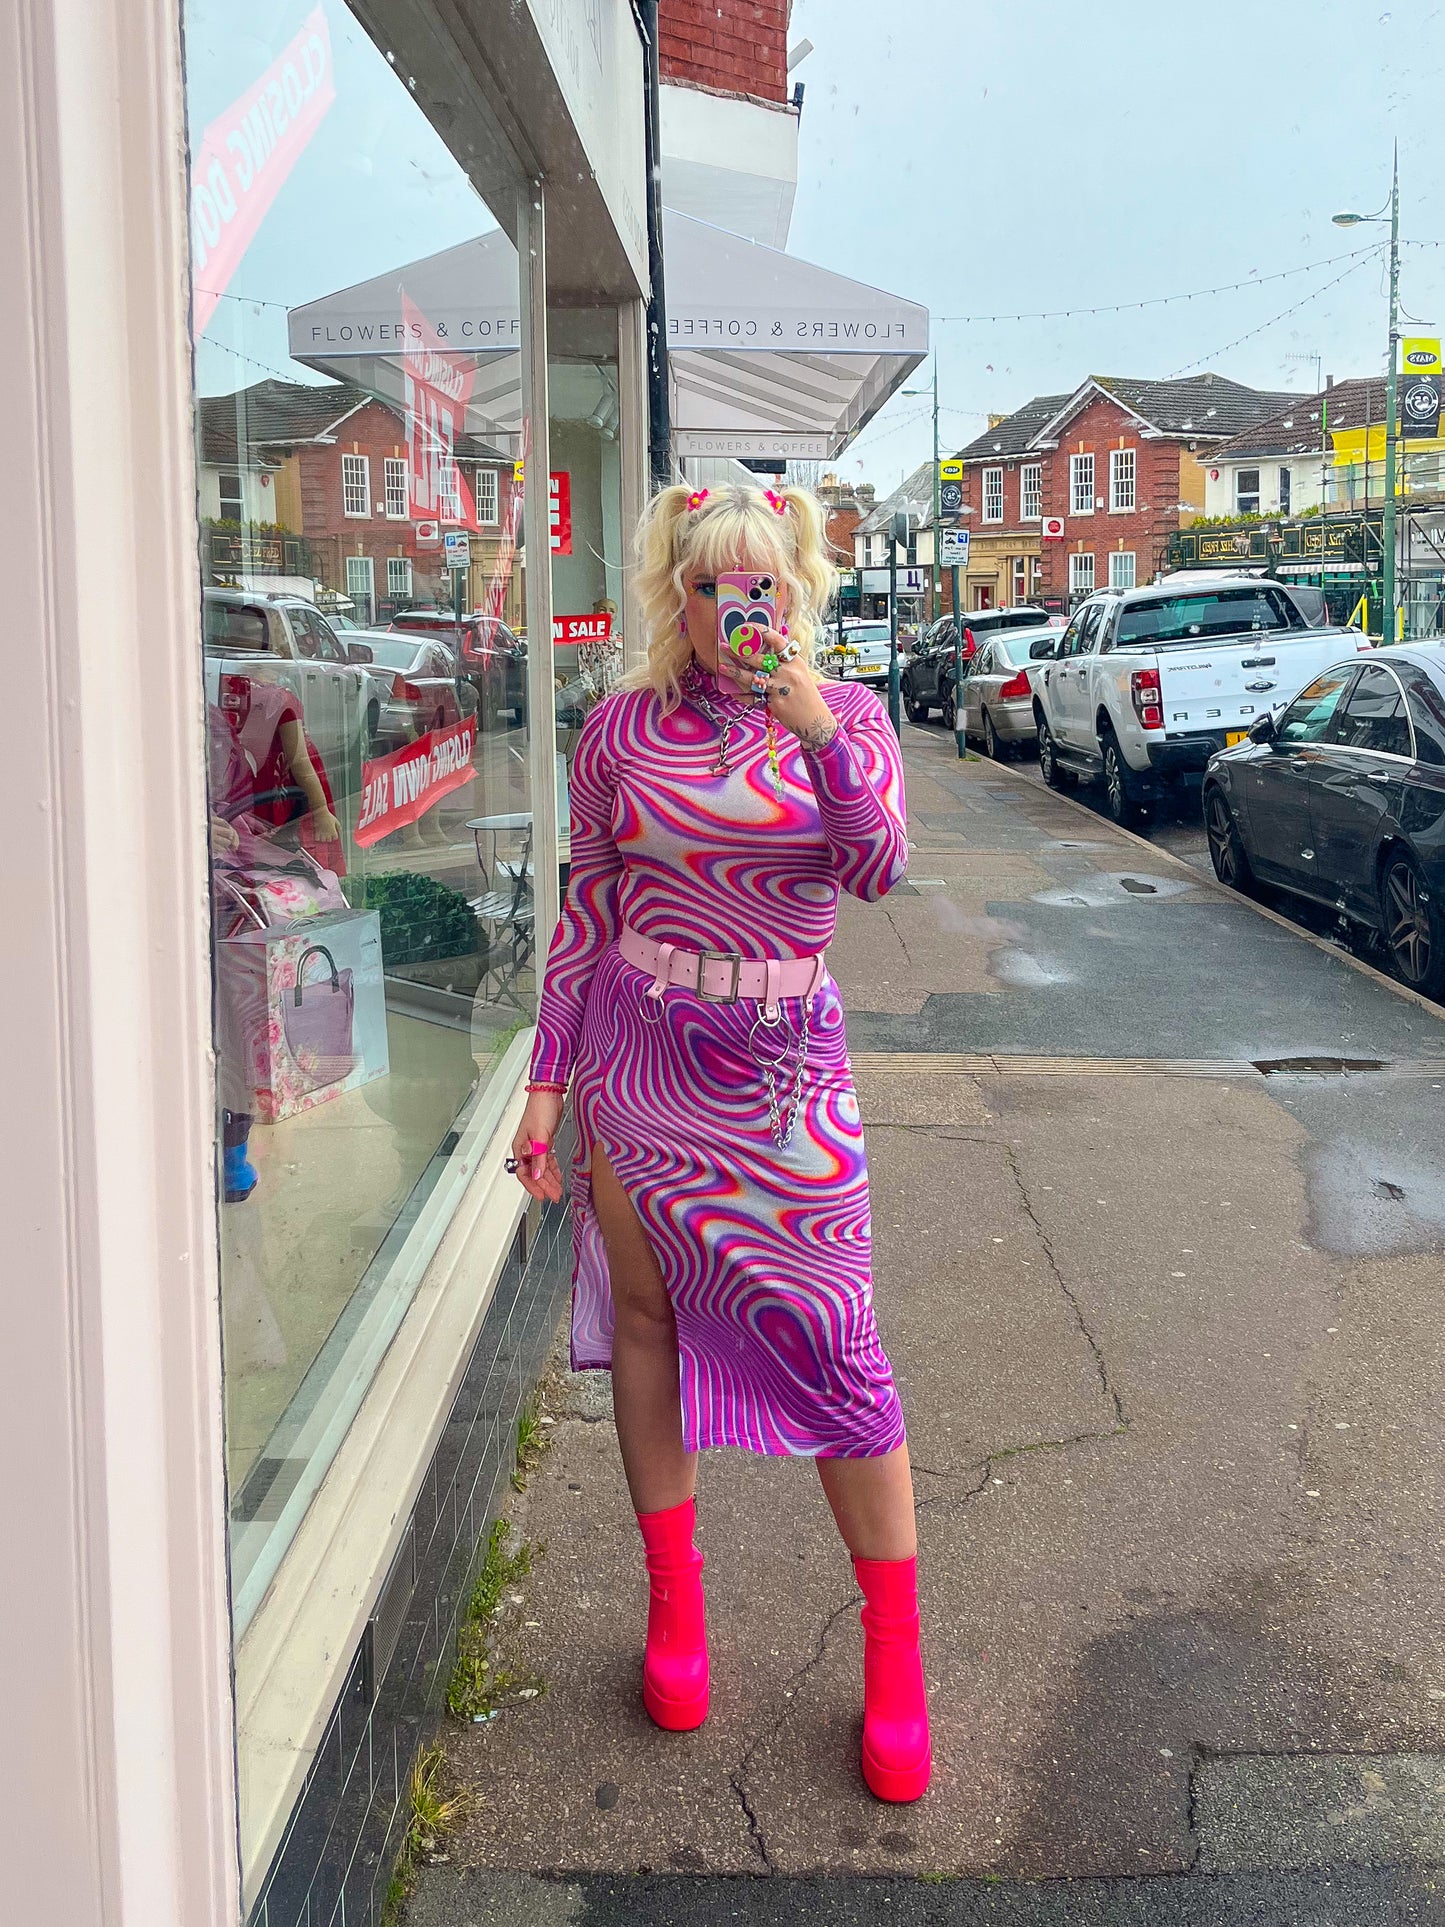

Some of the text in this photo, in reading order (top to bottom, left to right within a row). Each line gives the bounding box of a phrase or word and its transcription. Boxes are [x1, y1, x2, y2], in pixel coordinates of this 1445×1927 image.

[311, 319, 521, 341] FLOWERS & COFF
[689, 440, 823, 453] FLOWERS & COFFEE
[569, 621, 606, 638] SALE
